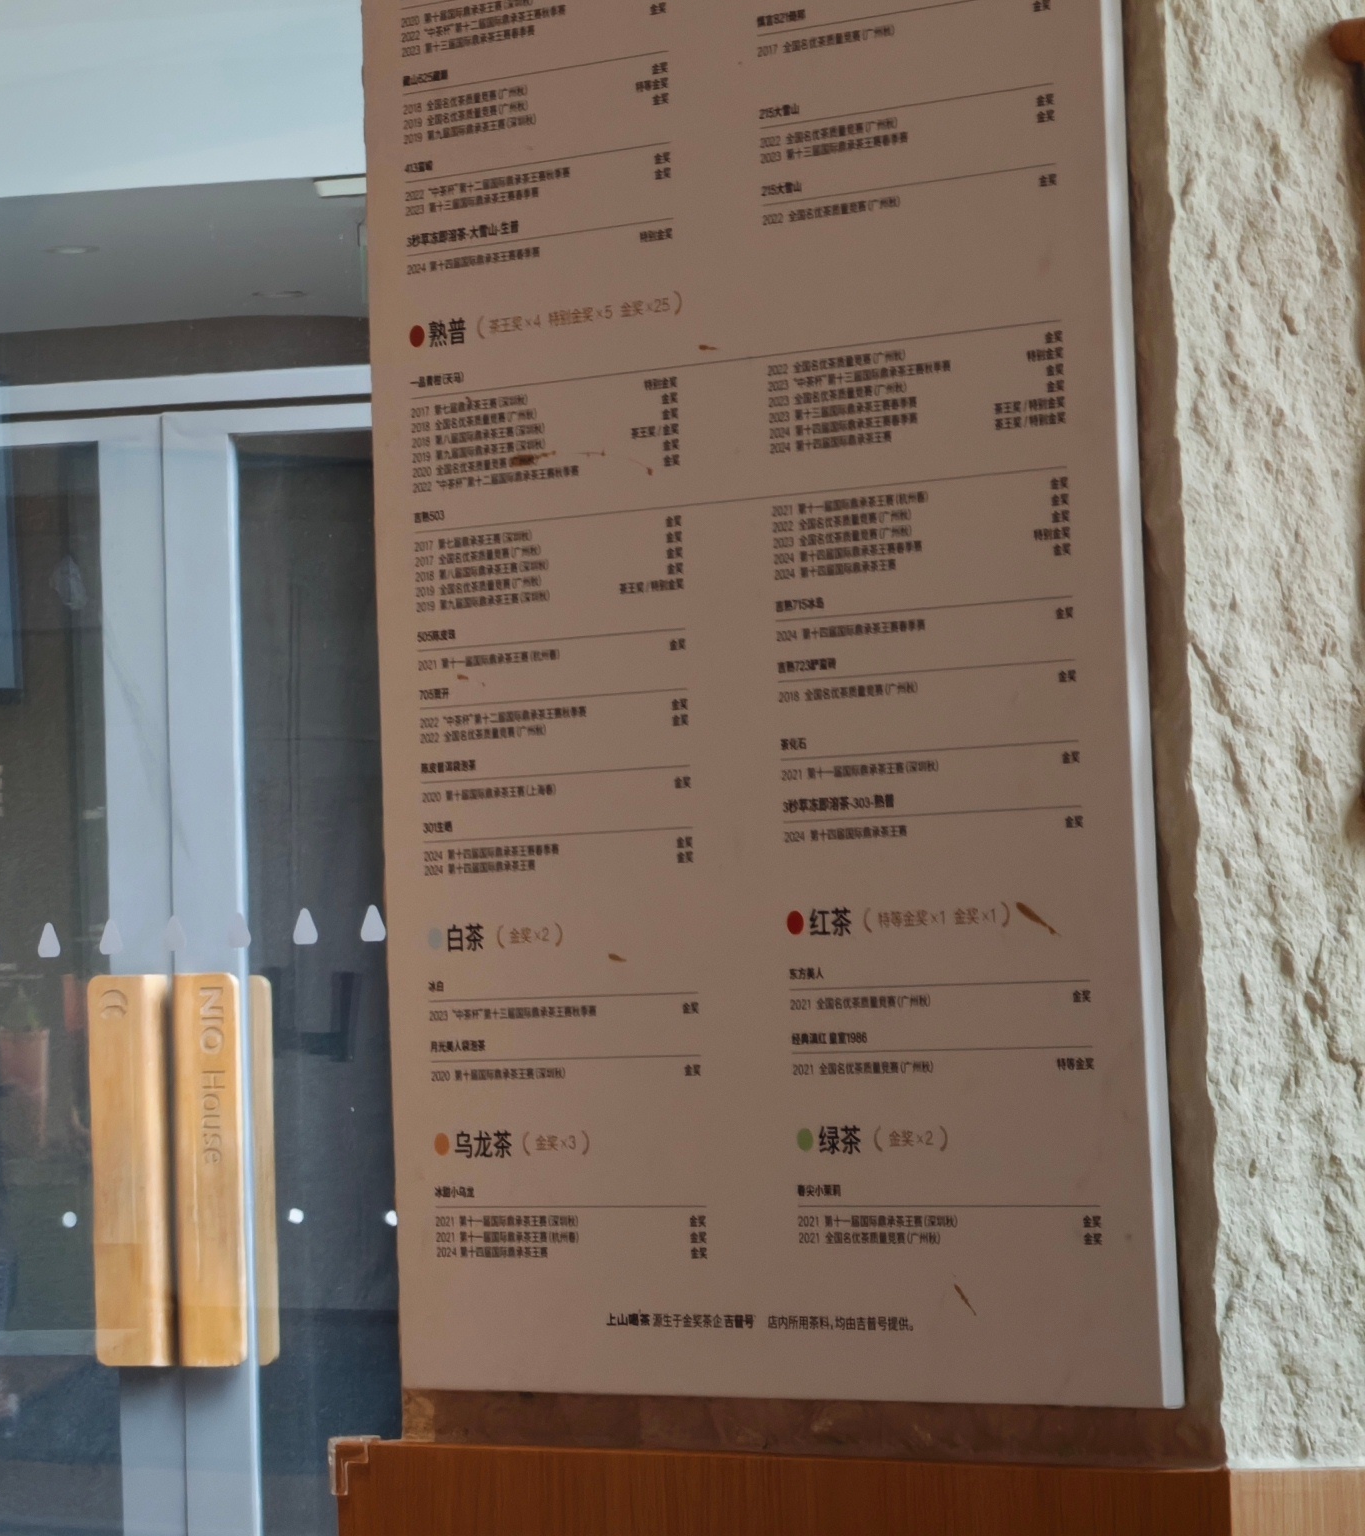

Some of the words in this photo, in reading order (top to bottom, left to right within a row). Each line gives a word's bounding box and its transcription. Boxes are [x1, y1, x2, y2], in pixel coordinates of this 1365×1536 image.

[756, 43, 778, 58] 2017
[758, 102, 800, 120] 215大雪山
[760, 180, 803, 197] 215大雪山
[427, 316, 466, 348] 熟普
[410, 405, 430, 419] 2017
[414, 554, 434, 568] 2017
[665, 529, 683, 545] 金奖
[1056, 668, 1077, 684] 金奖
[671, 712, 689, 727] 金奖
[780, 768, 803, 782] 2021
[1060, 749, 1081, 765] 金奖
[808, 906, 852, 937] 红茶
[446, 922, 484, 952] 白茶
[788, 966, 824, 981] 东方美人
[681, 1000, 700, 1015] 金奖
[789, 997, 812, 1011] 2021
[1071, 988, 1092, 1004] 金奖
[199, 986, 224, 1056] NIO
[791, 1063, 814, 1076] 2021
[1055, 1056, 1095, 1071] 特等金奖
[200, 1070, 226, 1164] House
[454, 1129, 512, 1159] 乌龙茶
[817, 1124, 861, 1156] 绿茶
[797, 1214, 819, 1228] 2021
[1082, 1214, 1102, 1229] 金奖
[435, 1231, 455, 1243] 2021
[688, 1230, 708, 1245] 金奖
[798, 1231, 820, 1244] 2021
[1082, 1231, 1103, 1246] 金奖
